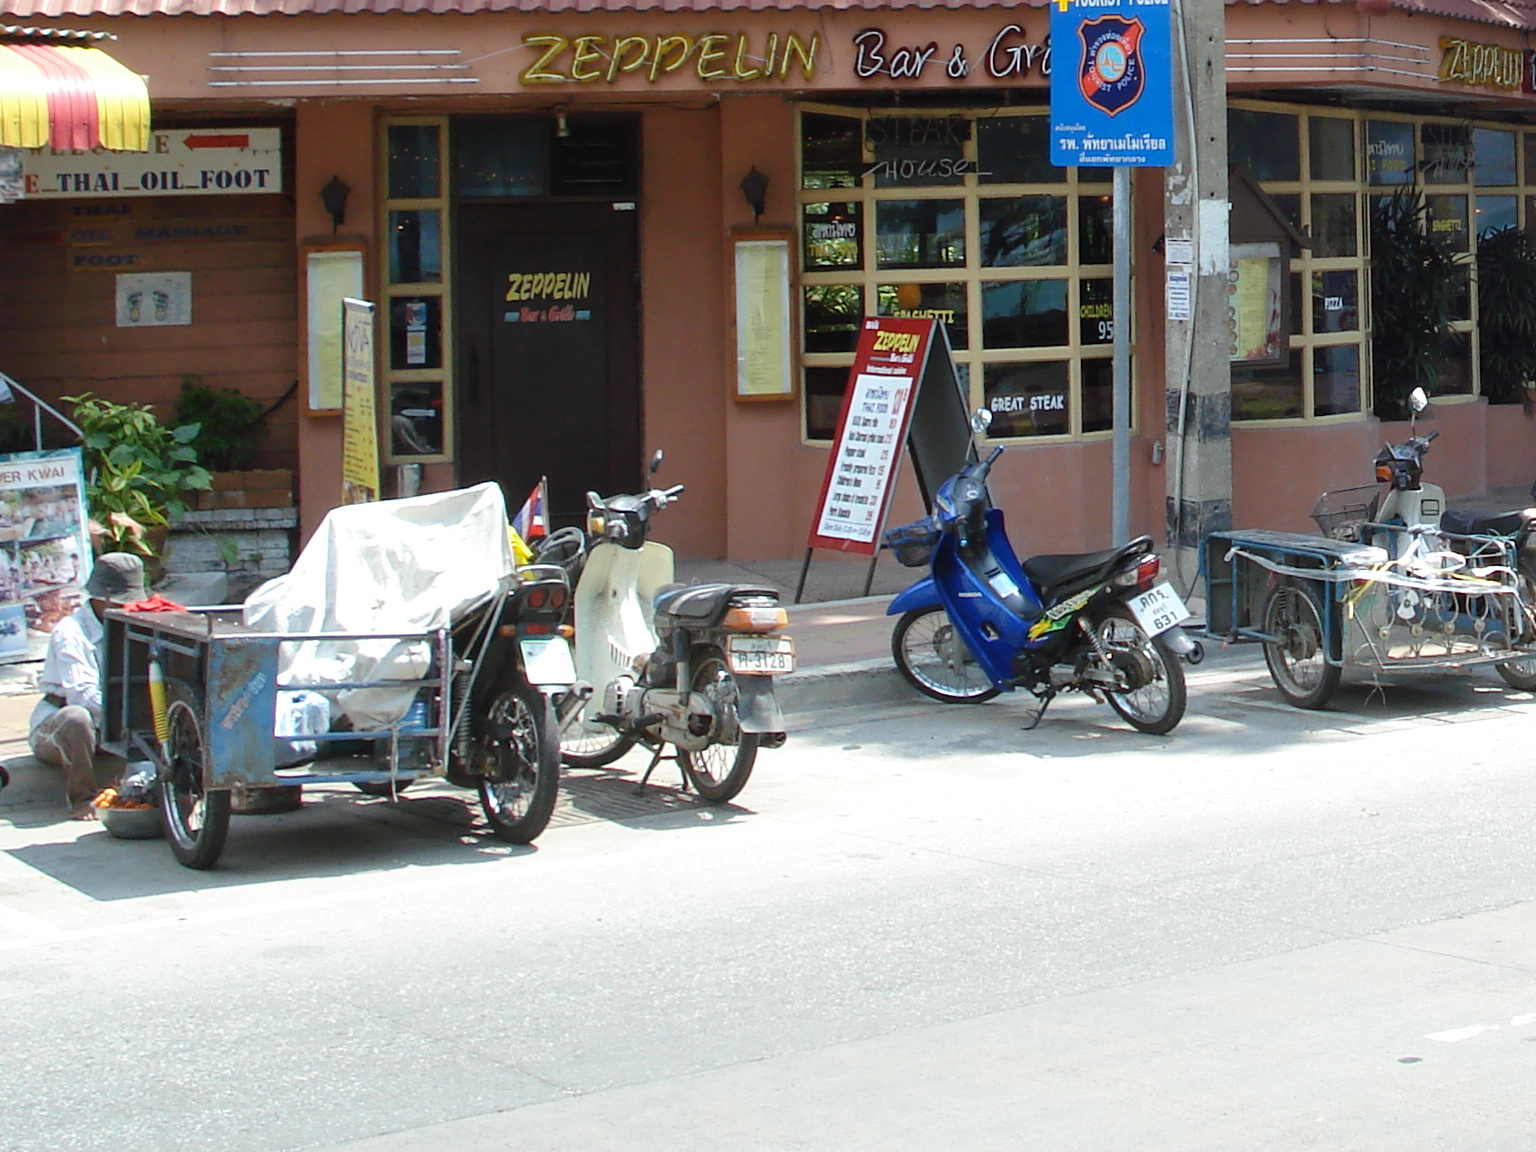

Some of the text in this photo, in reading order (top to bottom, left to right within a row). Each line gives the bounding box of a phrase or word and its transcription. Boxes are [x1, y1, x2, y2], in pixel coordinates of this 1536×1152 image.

[520, 31, 820, 84] ZEPPELIN
[853, 28, 938, 79] Bar
[946, 44, 969, 79] &
[1447, 40, 1524, 88] ZEPPELIN
[57, 173, 120, 192] THAI
[141, 171, 184, 191] OIL
[200, 169, 270, 190] FOOT
[506, 272, 590, 301] ZEPPELIN
[873, 330, 920, 353] ZEPPELIN
[991, 395, 1064, 412] GREAT STEAK
[28, 466, 64, 481] KWAI
[1153, 613, 1178, 630] 631
